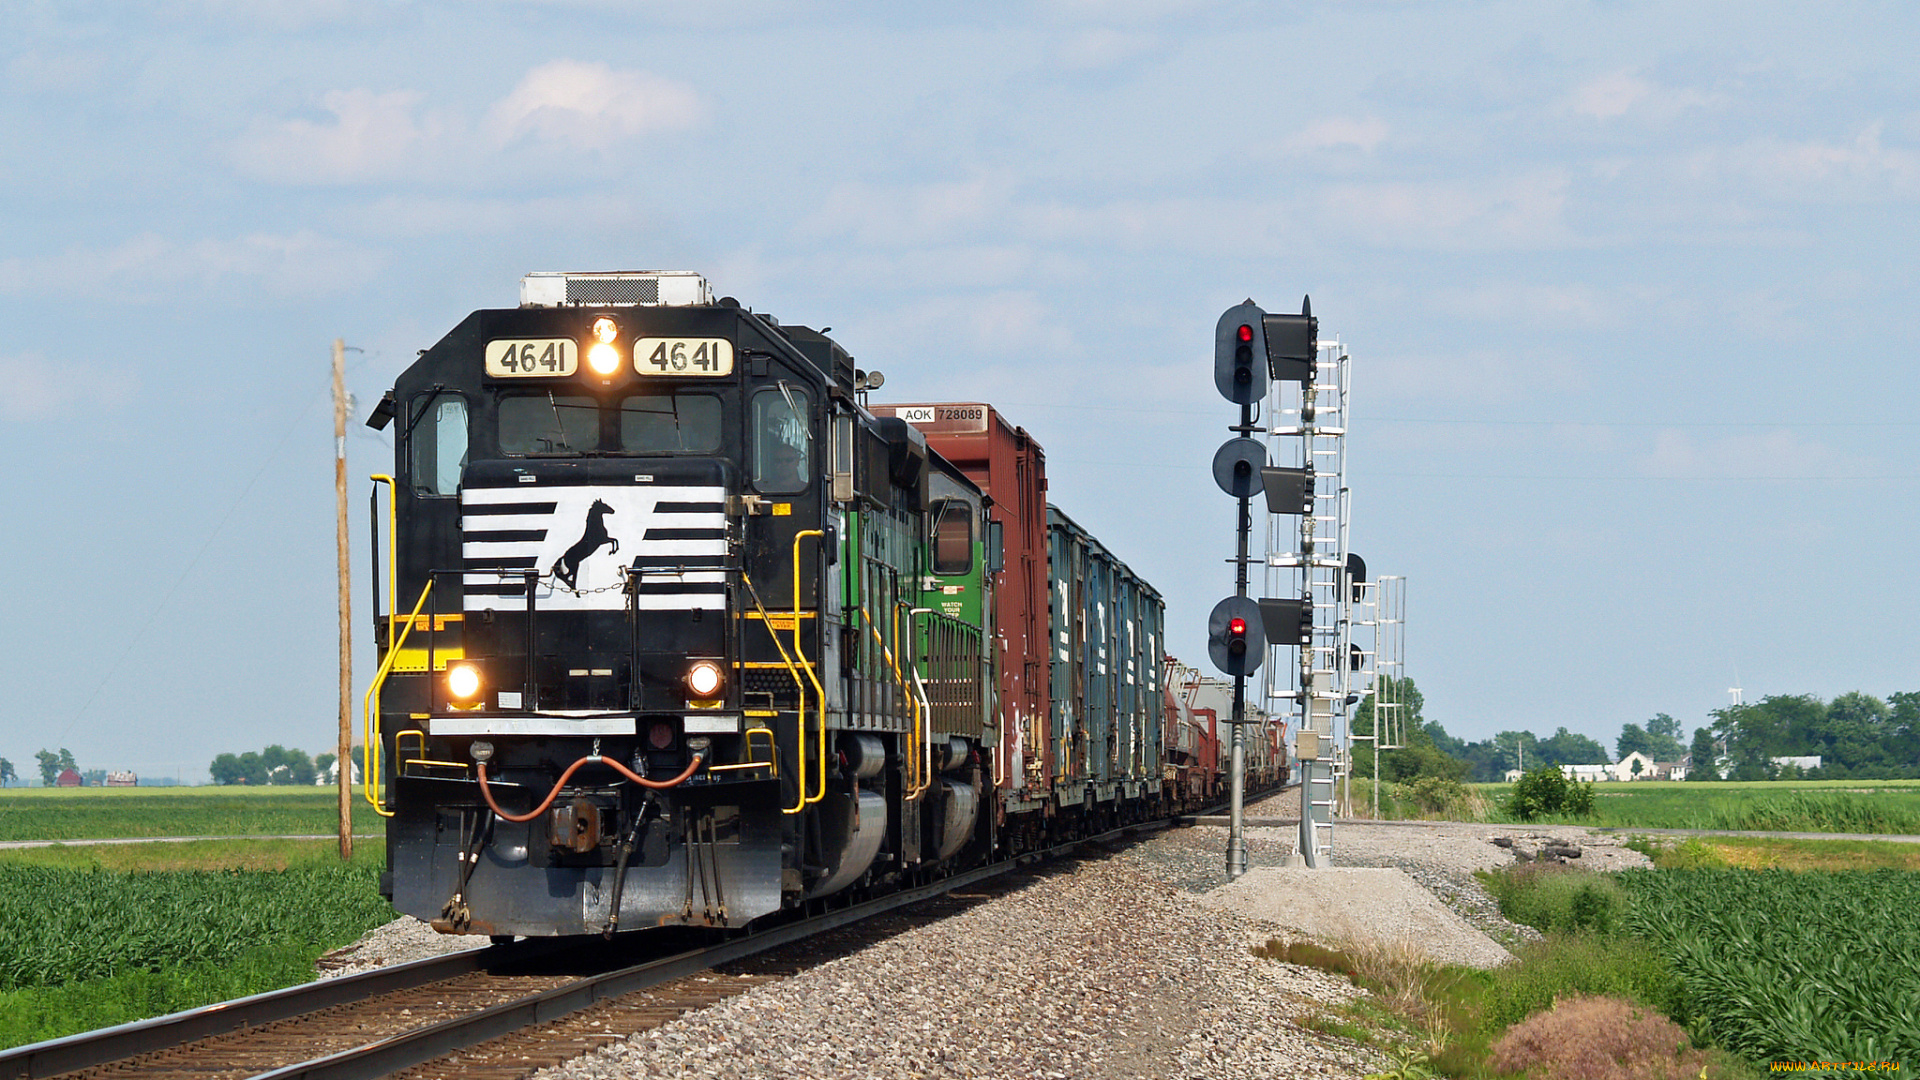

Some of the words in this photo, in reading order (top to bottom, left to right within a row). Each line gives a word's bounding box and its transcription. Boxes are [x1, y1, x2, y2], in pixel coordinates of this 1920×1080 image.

[500, 343, 565, 373] 4641
[649, 341, 718, 371] 4641
[905, 409, 932, 420] AOK
[938, 409, 983, 420] 728089
